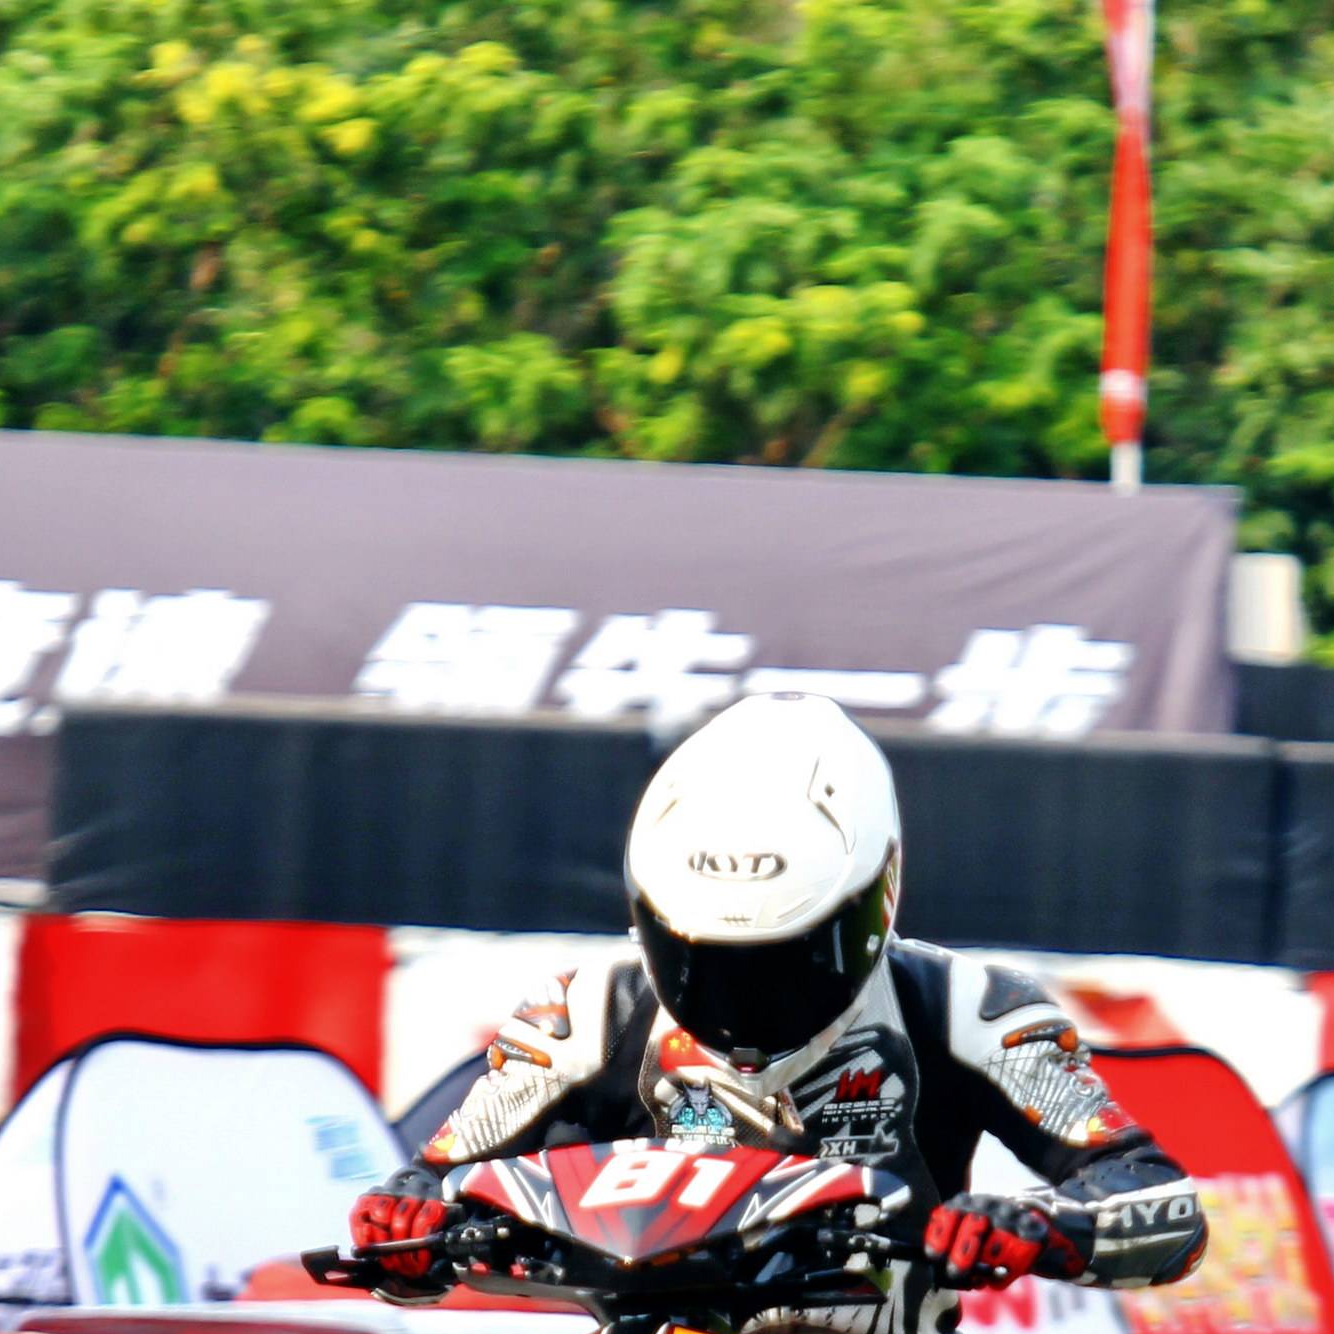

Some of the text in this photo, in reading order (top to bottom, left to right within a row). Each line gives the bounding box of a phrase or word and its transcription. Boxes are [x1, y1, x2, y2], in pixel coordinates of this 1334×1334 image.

[691, 849, 780, 877] KYT
[827, 1140, 858, 1156] XH
[578, 1149, 736, 1210] 81
